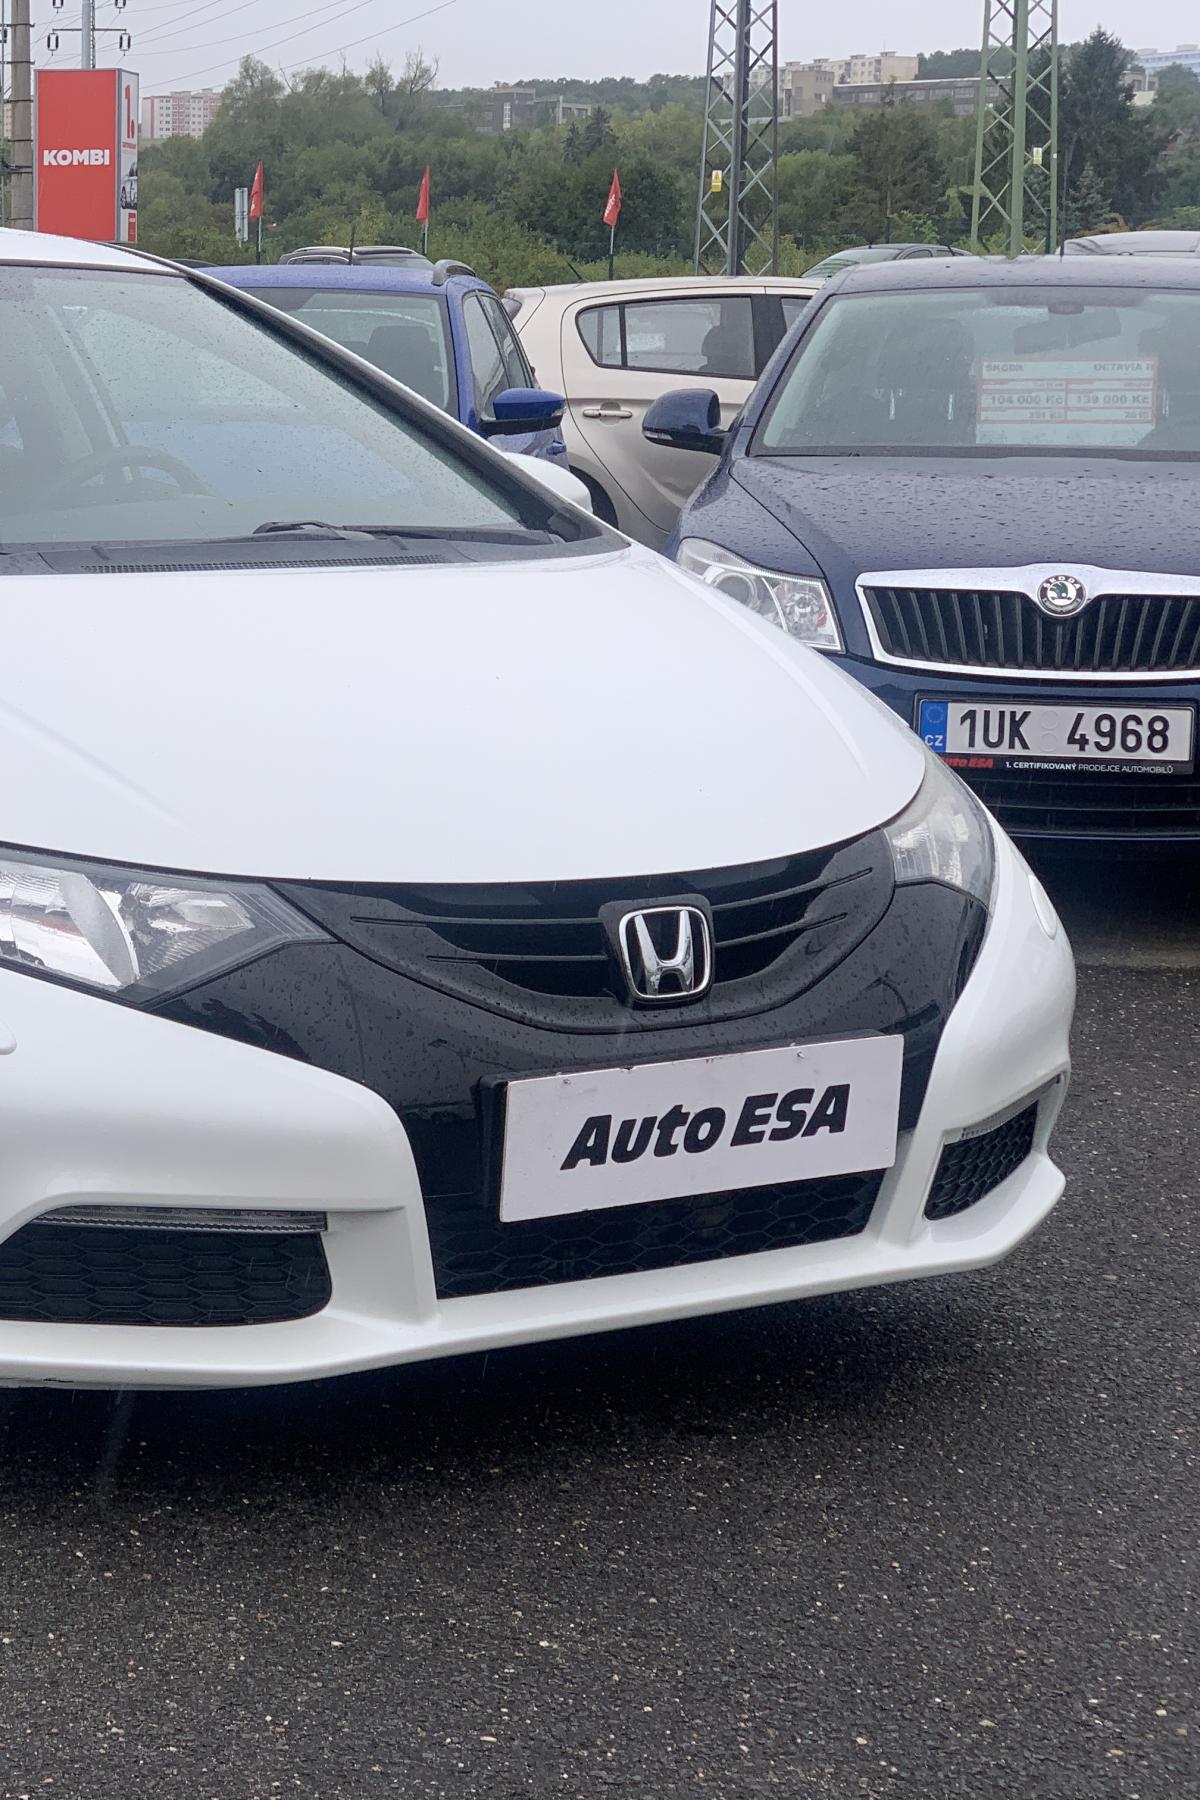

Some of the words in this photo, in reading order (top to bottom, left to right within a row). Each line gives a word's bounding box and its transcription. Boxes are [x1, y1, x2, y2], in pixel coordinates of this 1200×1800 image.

[43, 149, 110, 166] KOMBI
[960, 709, 1032, 750] 1UK
[1067, 713, 1170, 753] 4968
[924, 734, 944, 747] CZ
[1005, 761, 1012, 769] 1.
[1013, 761, 1077, 771] CERTIFIKOVANÝ
[1078, 764, 1120, 773] PRODEJCE
[1121, 764, 1174, 774] AUTOMOBILŮ
[560, 1104, 726, 1170] Auto
[730, 1083, 851, 1147] ESA
